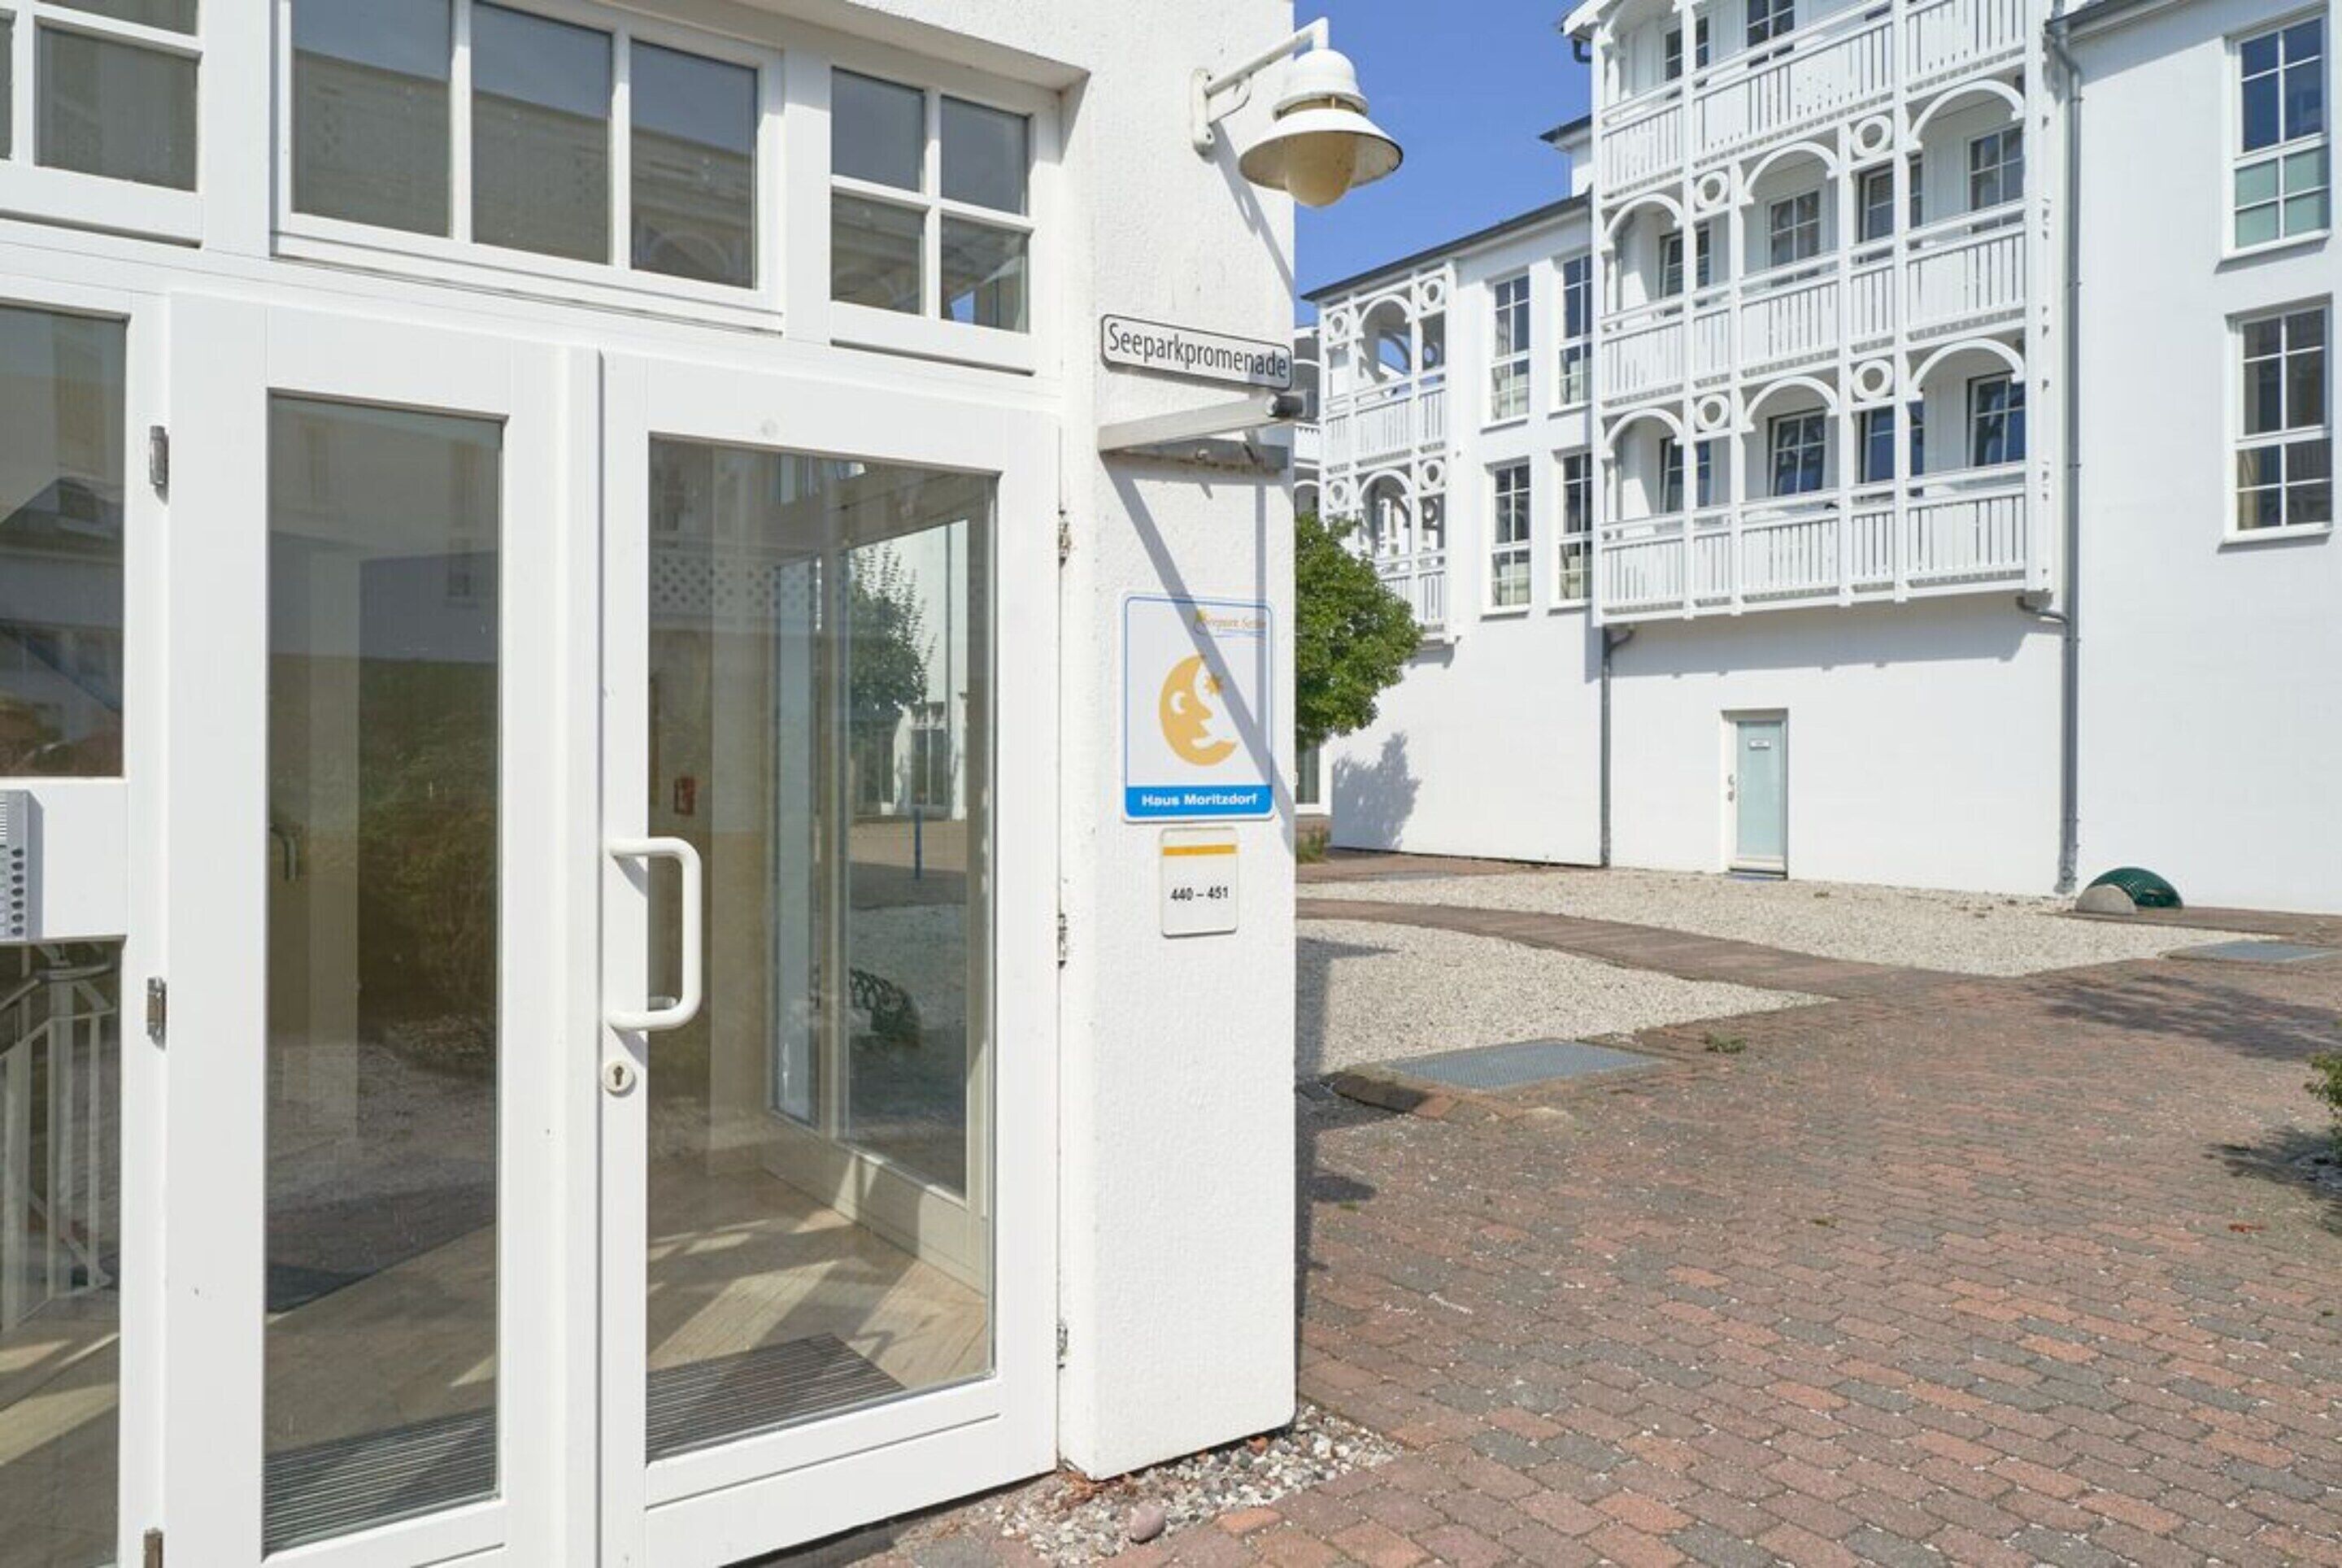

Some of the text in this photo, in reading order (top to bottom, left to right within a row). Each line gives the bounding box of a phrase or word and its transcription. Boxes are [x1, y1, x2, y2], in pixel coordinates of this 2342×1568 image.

[1108, 322, 1286, 379] Seeparkpromenade
[1141, 793, 1258, 807] Haus Moritzdorf
[1170, 886, 1194, 901] 440
[1207, 885, 1229, 899] 451
